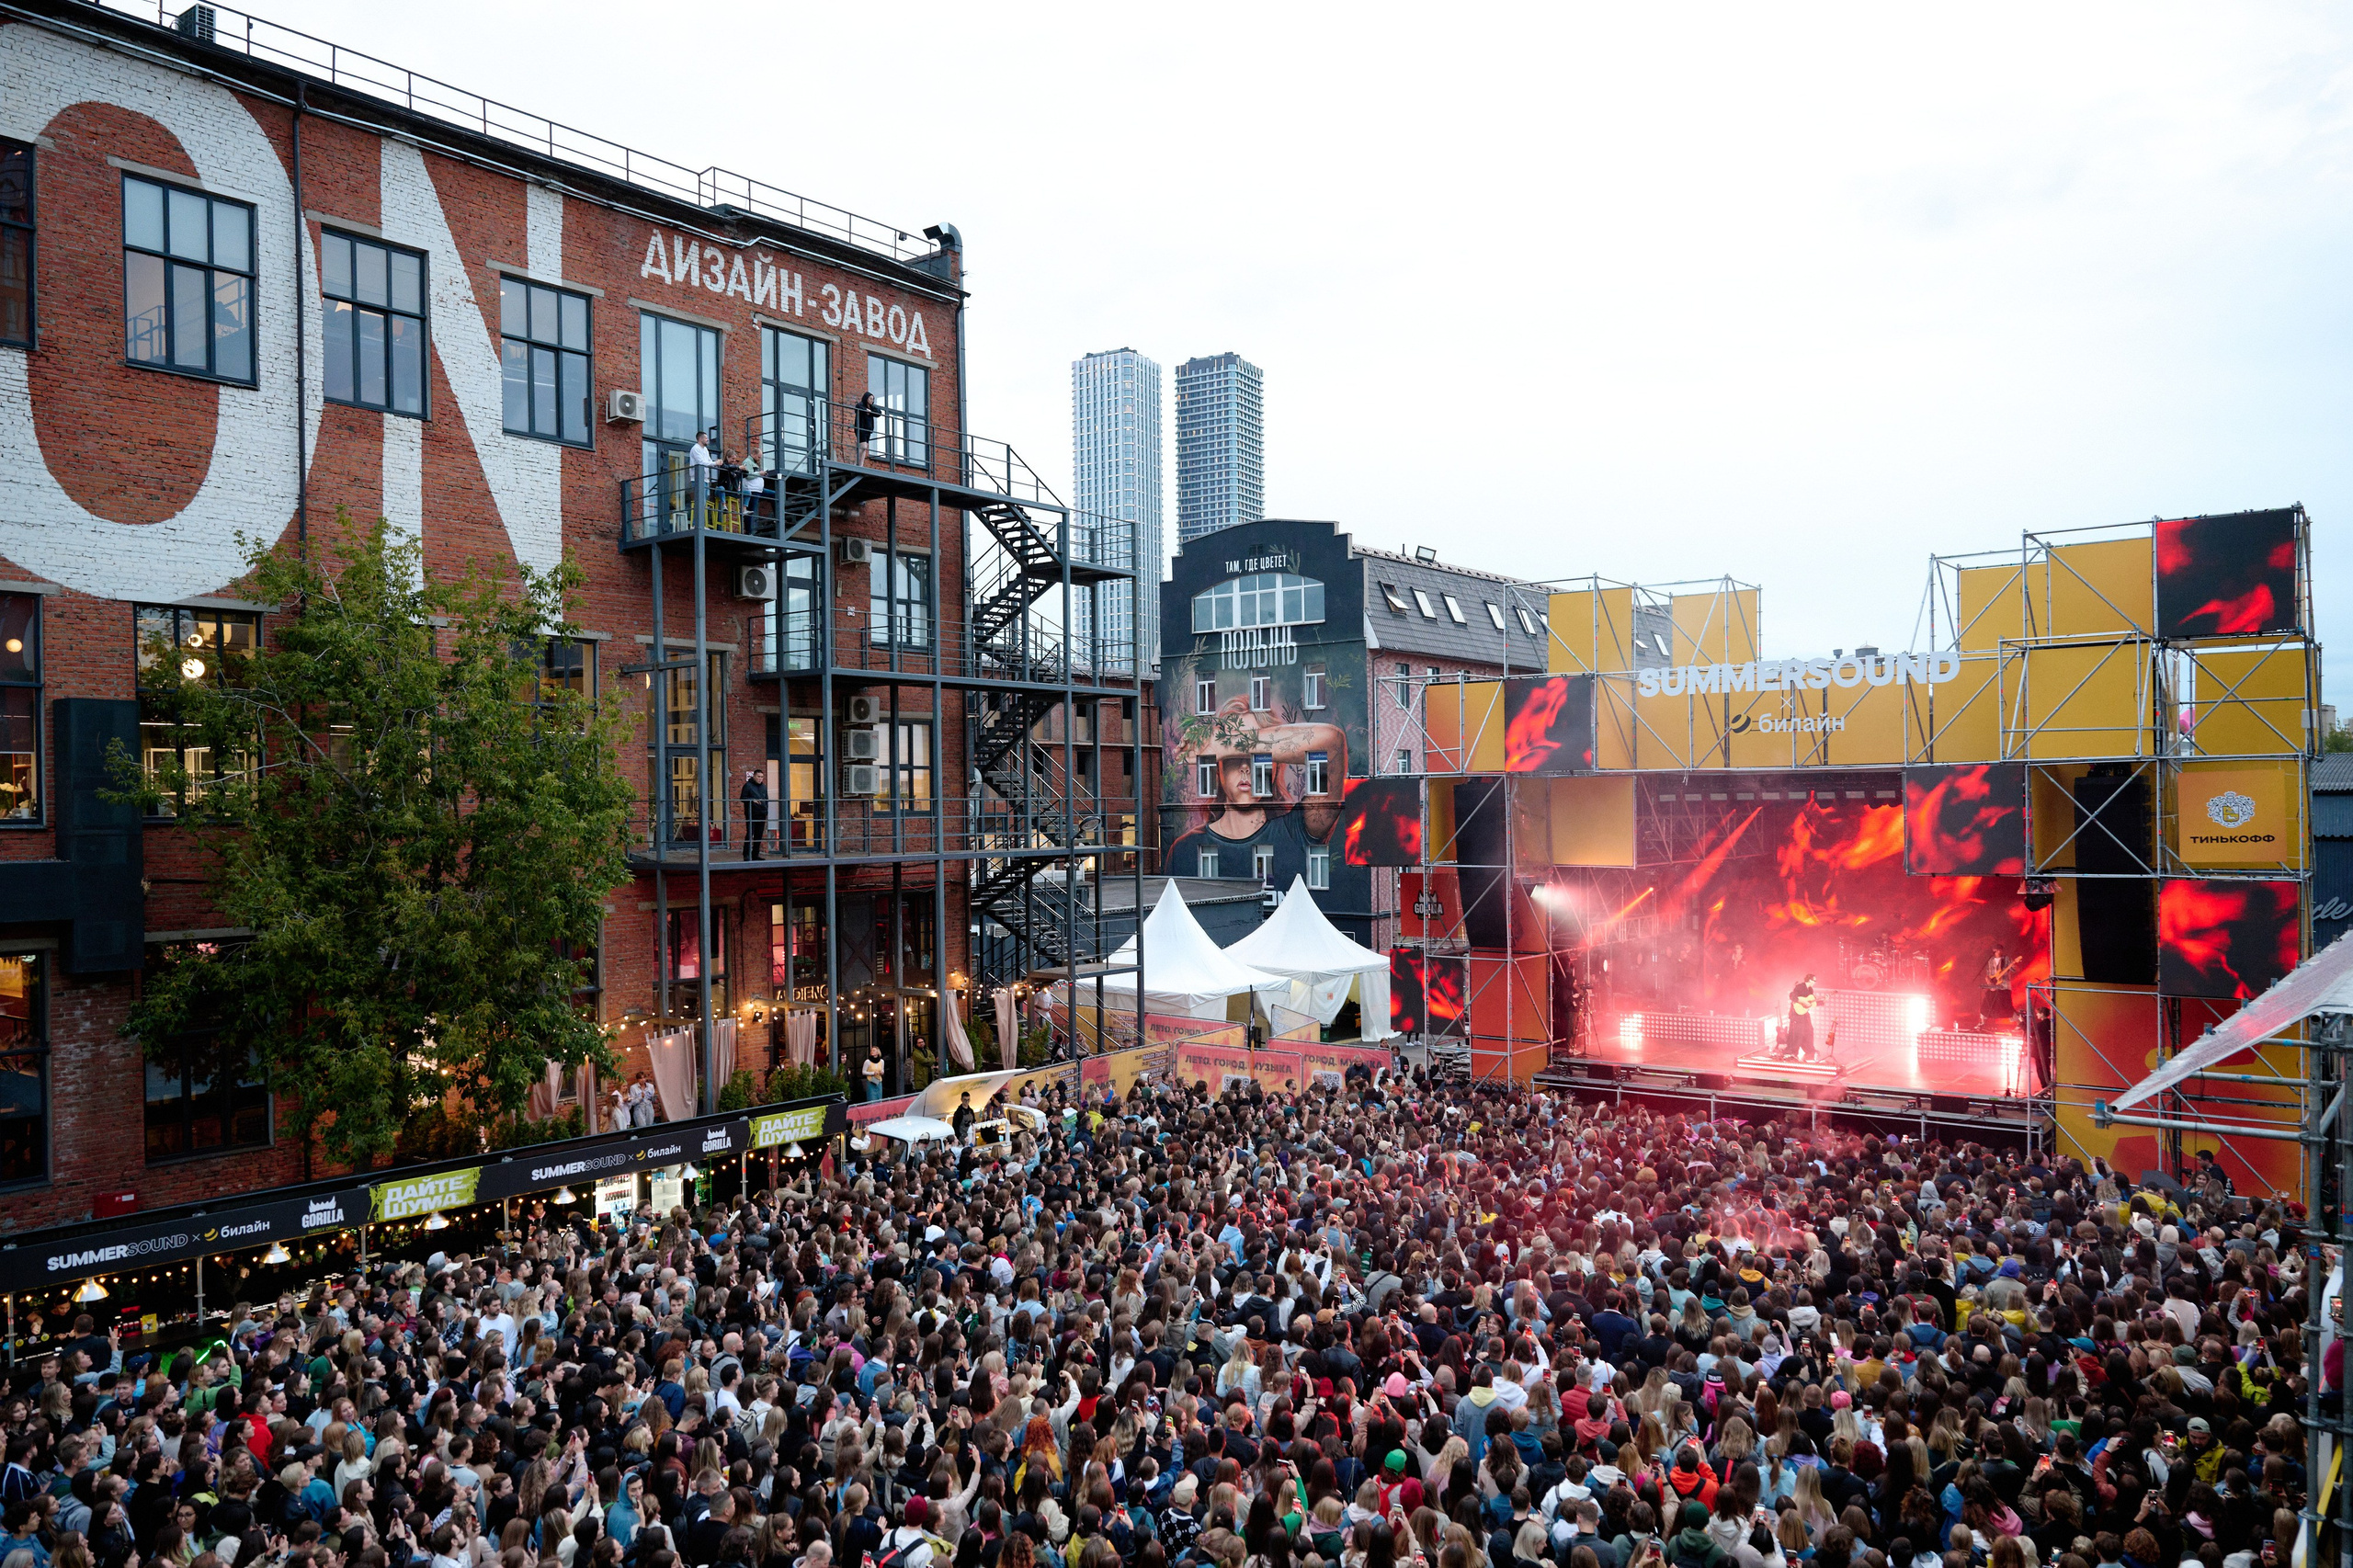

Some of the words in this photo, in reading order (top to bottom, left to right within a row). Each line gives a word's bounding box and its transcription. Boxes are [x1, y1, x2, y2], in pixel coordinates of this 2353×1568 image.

[641, 228, 933, 359] ДИЗАЙН-ЗАВОД
[1225, 560, 1243, 574] ТАМ,
[1245, 558, 1258, 572] ГДЕ
[1260, 554, 1288, 570] ЦВЕТЕТ
[1221, 626, 1298, 670] ПОЛЫНЬ
[1638, 651, 1961, 699] SUMMERSOUND
[1758, 712, 1846, 734] билайн
[2189, 835, 2276, 844] ТИНЬКОФФ
[1185, 1055, 1211, 1065] ЛЕТО.
[1213, 1058, 1248, 1070] ГОРОД.
[761, 1111, 817, 1132] ДАЙТЕ
[702, 1136, 732, 1153] GORILLA
[531, 1153, 626, 1181] SUMMERSOUND
[647, 1144, 681, 1159] билайн
[384, 1175, 471, 1203] ДАЙТЕ
[301, 1209, 345, 1229] GORILLA
[47, 1233, 189, 1271] SUMMERSOUND
[221, 1220, 270, 1239] билайн
